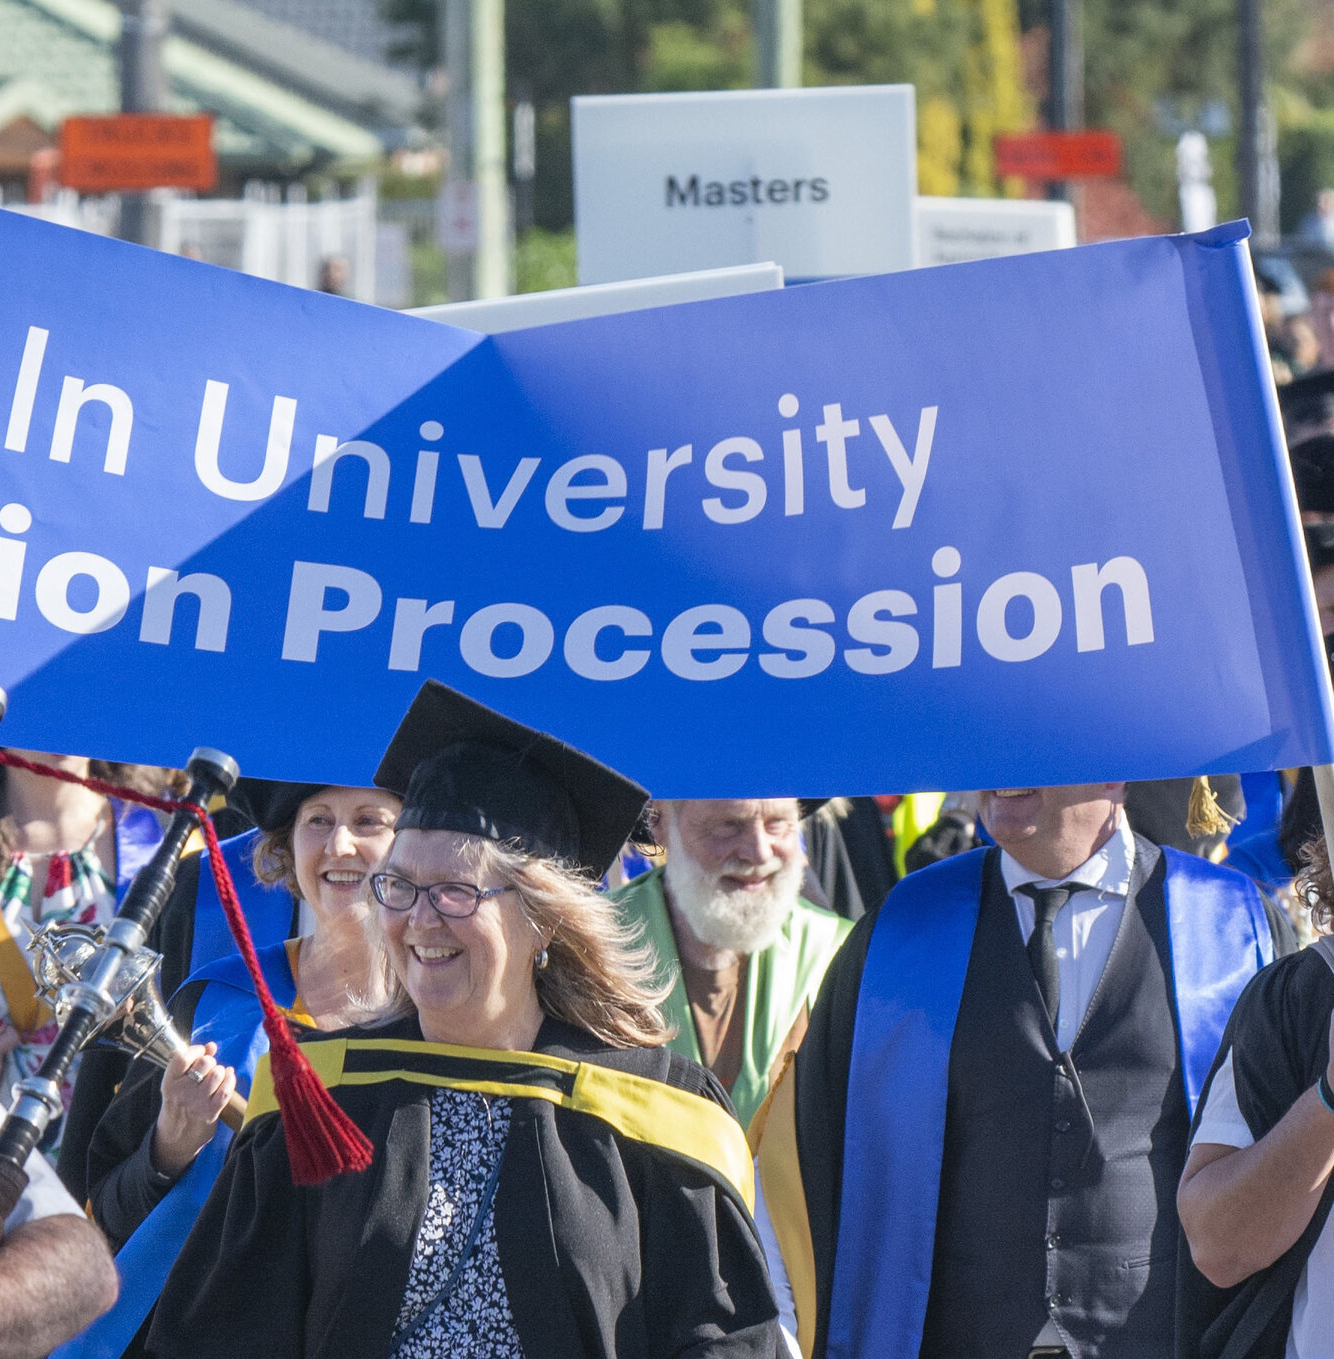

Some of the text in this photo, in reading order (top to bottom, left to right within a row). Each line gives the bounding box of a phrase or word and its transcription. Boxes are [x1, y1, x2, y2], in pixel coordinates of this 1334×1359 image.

[665, 174, 830, 206] Masters
[193, 378, 940, 530] University
[281, 545, 1156, 681] Procession
